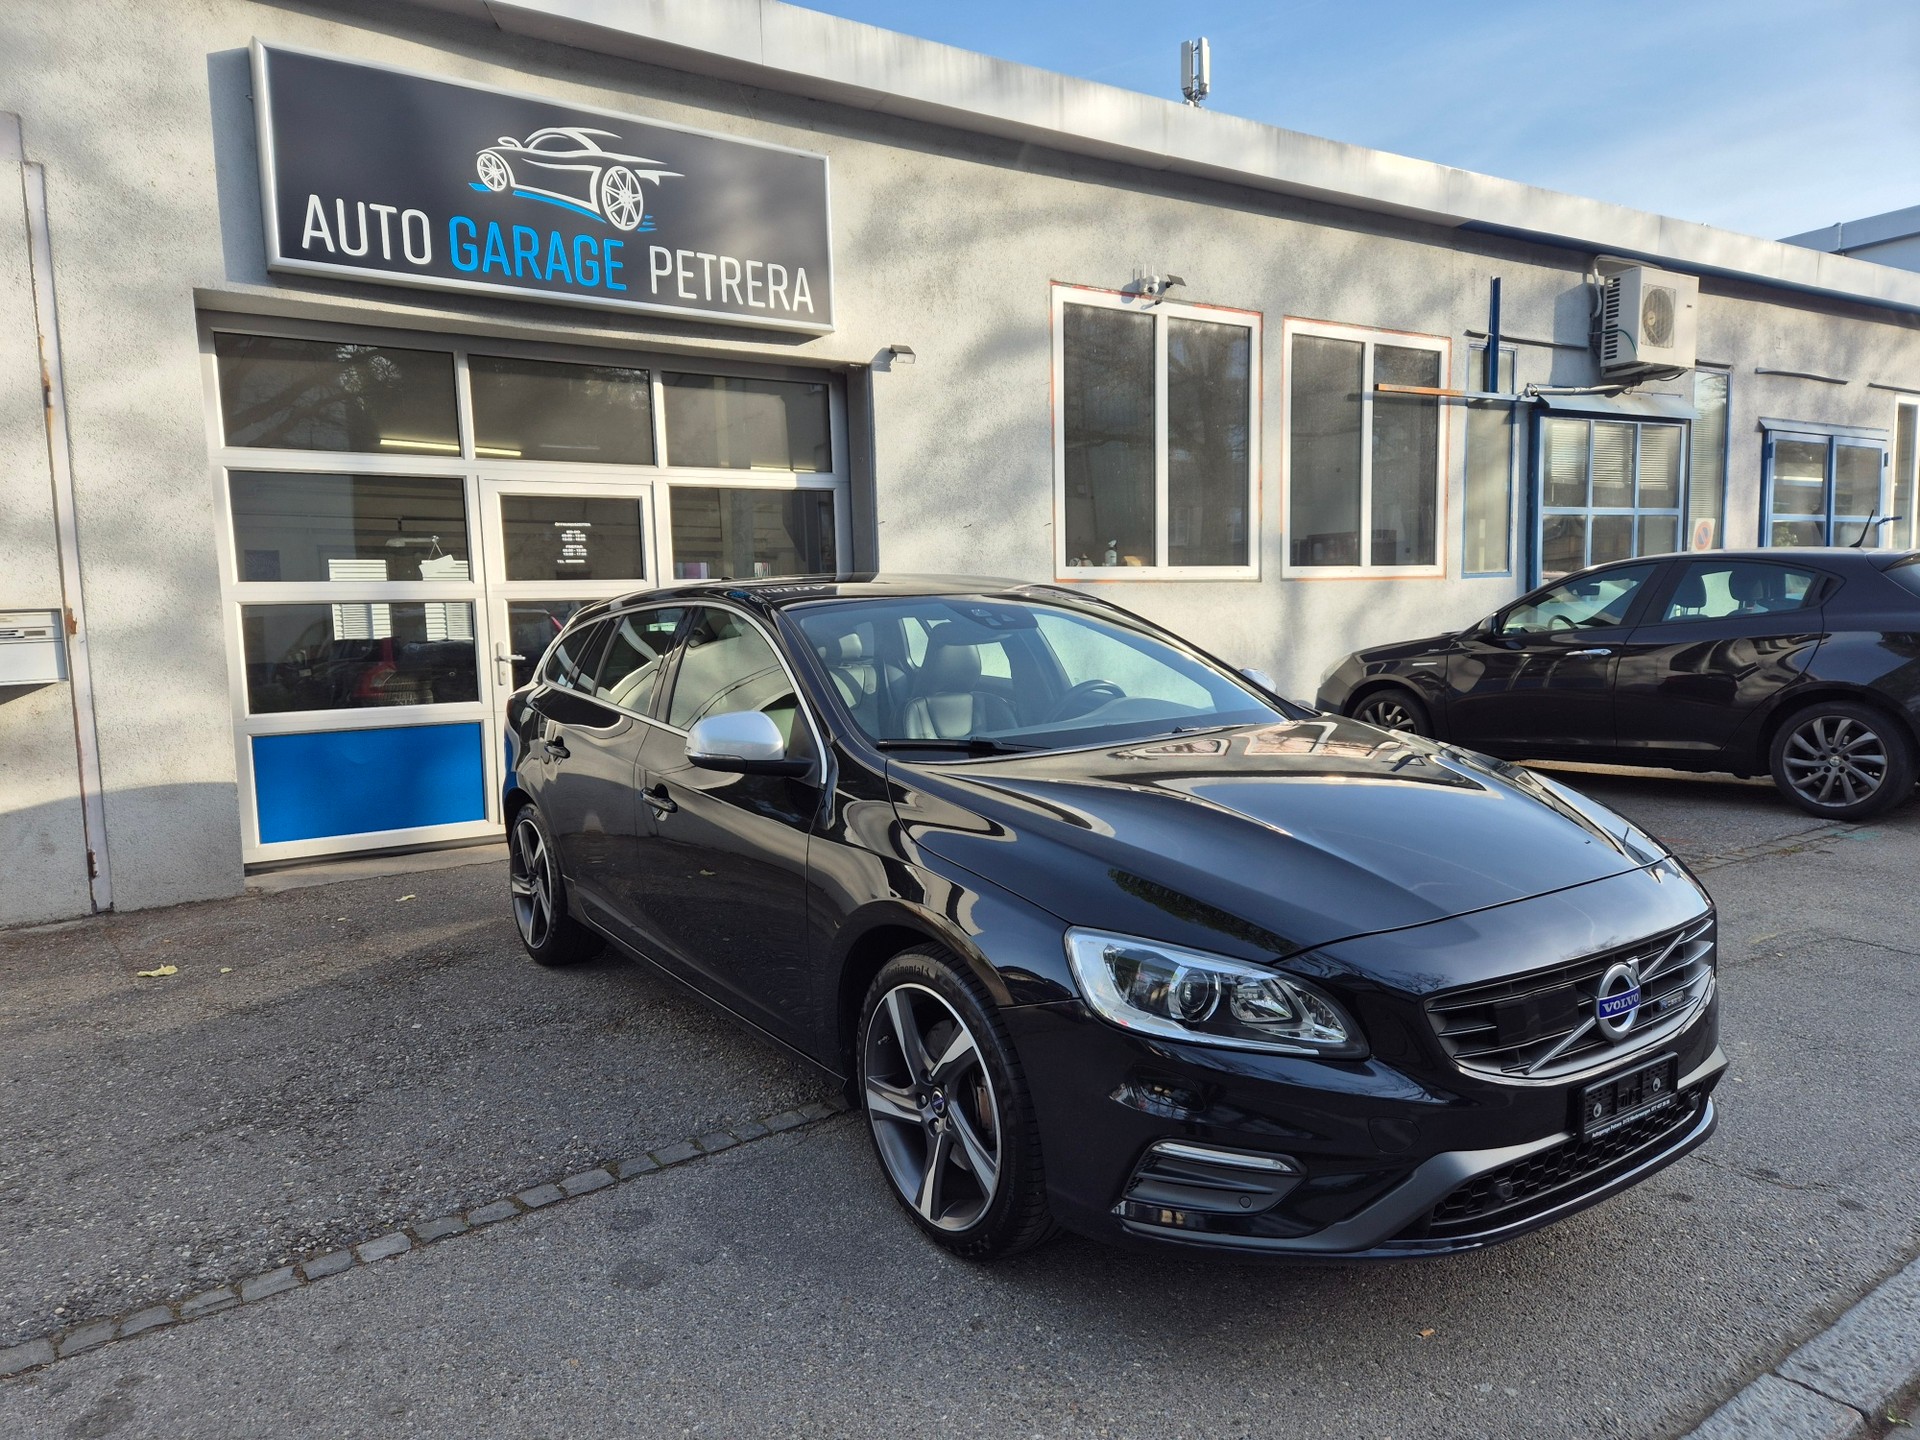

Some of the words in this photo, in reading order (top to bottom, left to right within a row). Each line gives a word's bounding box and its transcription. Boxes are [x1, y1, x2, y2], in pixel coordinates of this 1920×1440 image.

[302, 194, 432, 265] AUTO
[448, 215, 627, 291] GARAGE
[649, 246, 815, 314] PETRERA
[1602, 992, 1640, 1013] VOLVO
